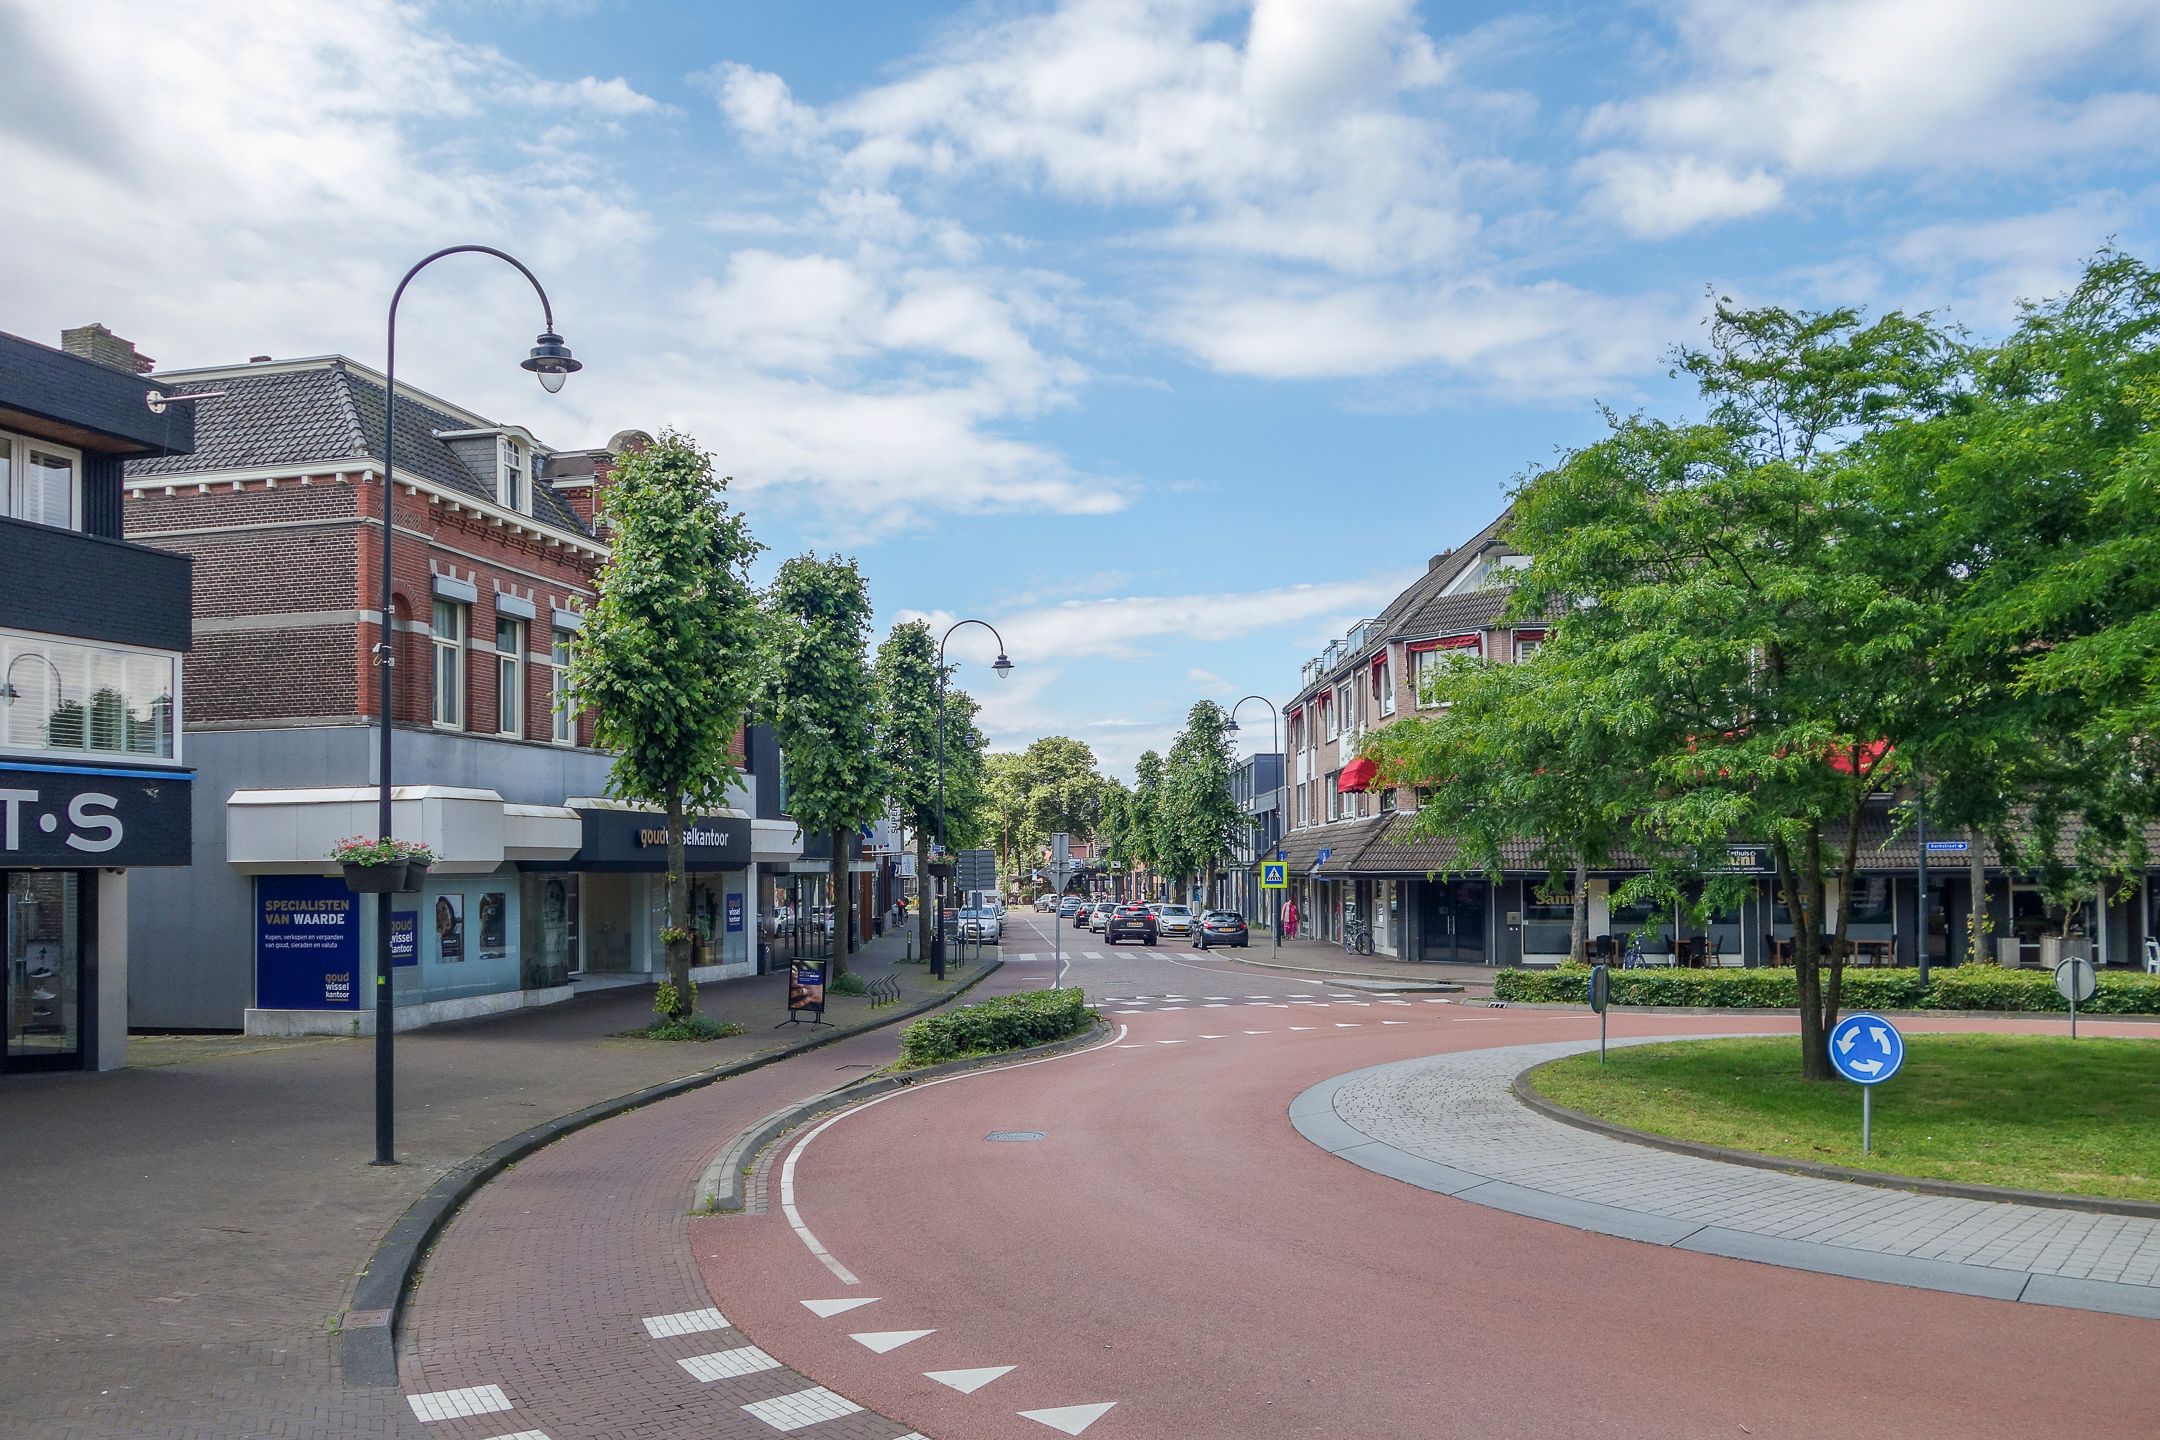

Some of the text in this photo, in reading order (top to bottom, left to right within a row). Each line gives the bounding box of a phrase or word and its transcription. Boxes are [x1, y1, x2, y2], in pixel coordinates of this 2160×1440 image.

[641, 826, 729, 848] goudselkantoor
[265, 900, 349, 911] SPECIALISTEN
[265, 913, 345, 925] VAN WAARDE
[325, 971, 349, 983] goud
[325, 982, 350, 990] wissel
